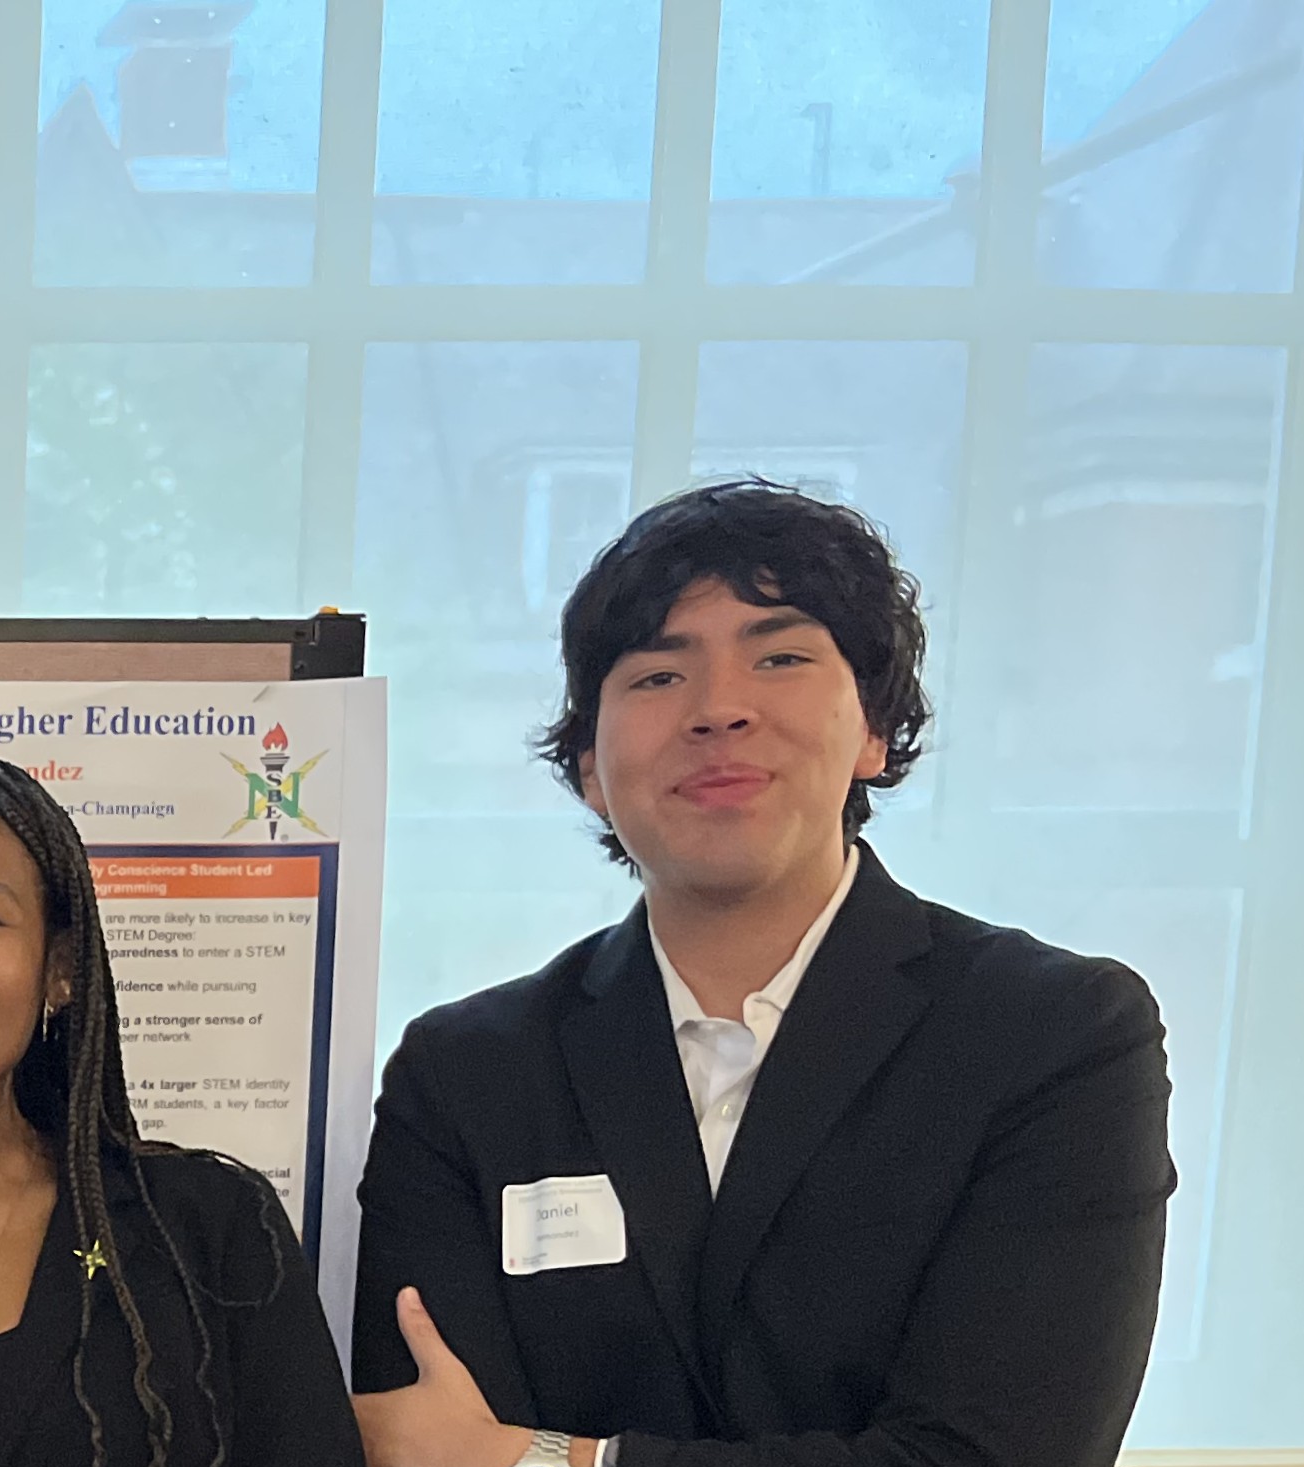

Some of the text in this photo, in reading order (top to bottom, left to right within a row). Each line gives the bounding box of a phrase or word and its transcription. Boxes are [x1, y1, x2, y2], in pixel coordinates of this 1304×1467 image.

[84, 705, 257, 737] Education
[139, 1079, 198, 1094] 4x larger
